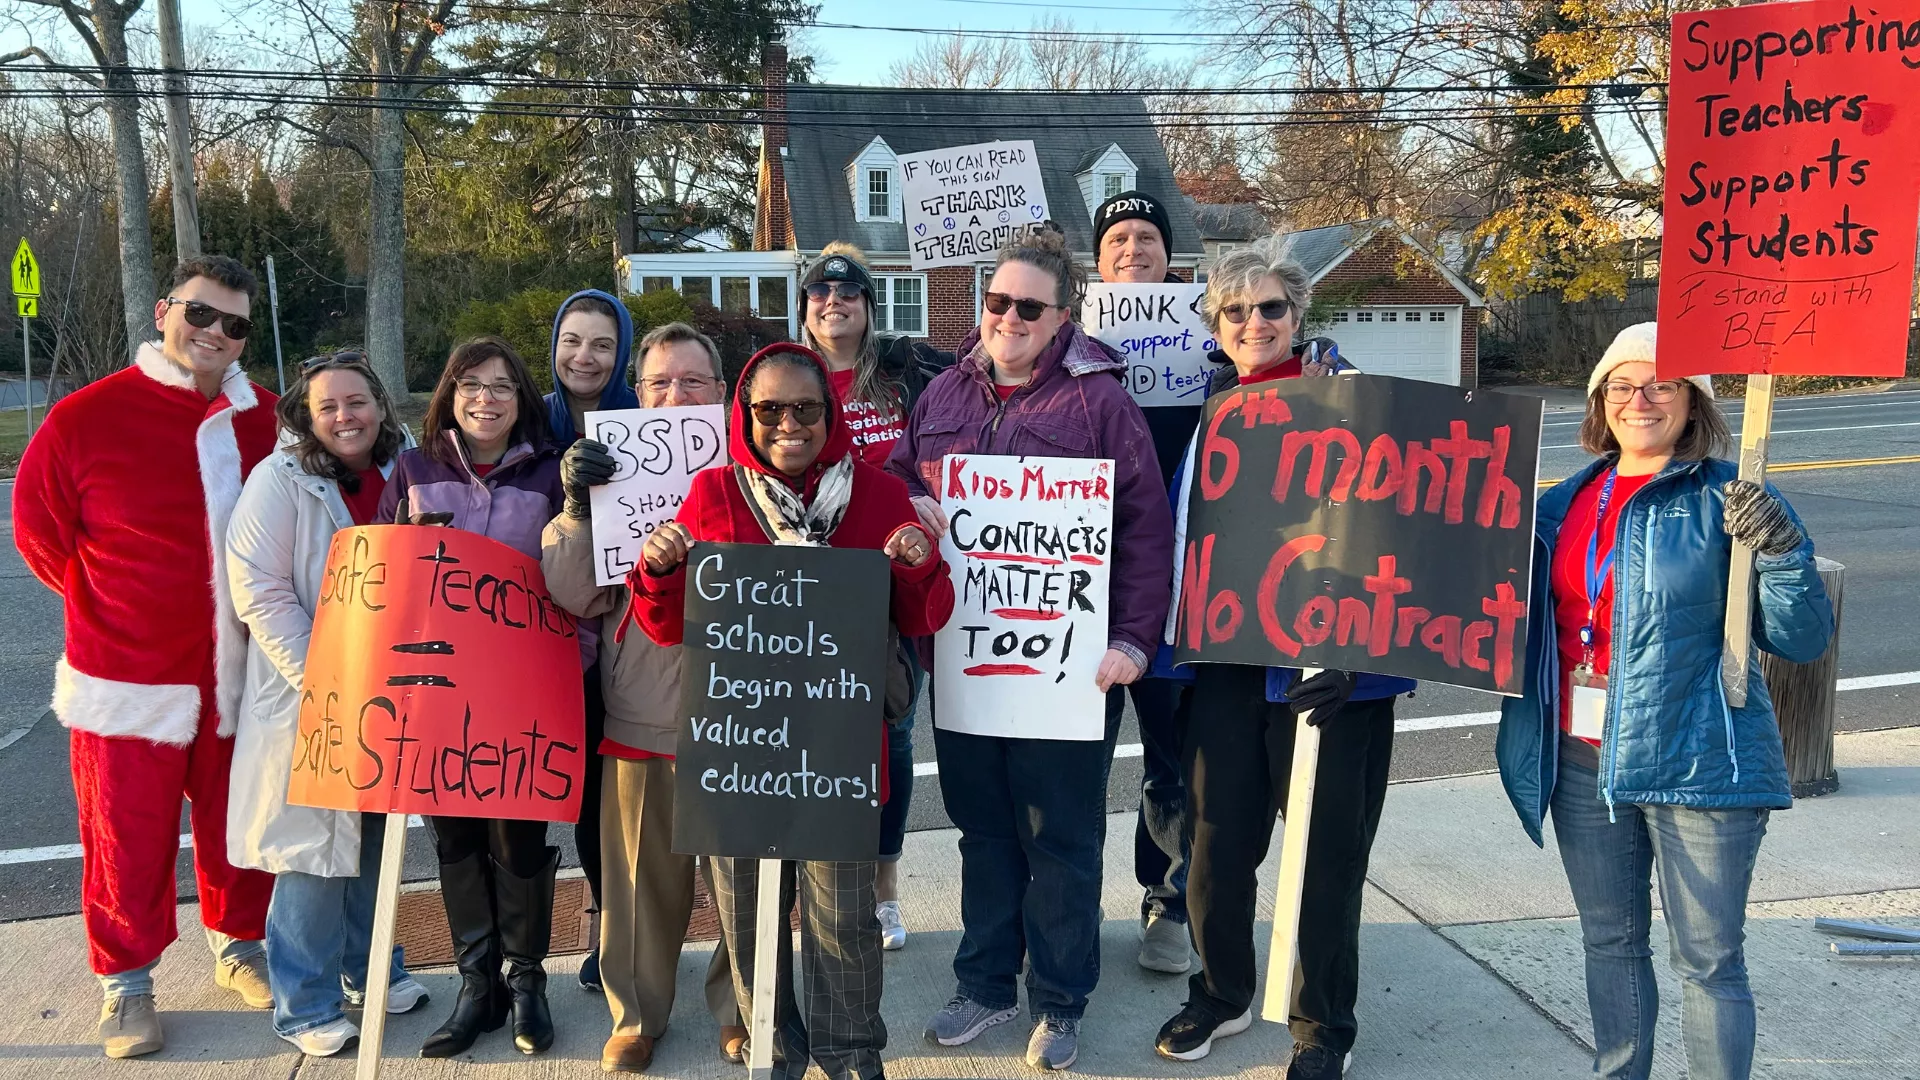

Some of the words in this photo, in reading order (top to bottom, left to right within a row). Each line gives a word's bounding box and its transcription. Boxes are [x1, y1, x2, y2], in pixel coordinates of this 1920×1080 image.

[1684, 5, 1920, 81] Supporting
[1696, 79, 1868, 137] Teachers
[903, 160, 919, 181] IF
[925, 158, 952, 176] YOU
[956, 153, 983, 171] CAN
[988, 148, 1026, 168] READ
[939, 174, 968, 187] THIS
[973, 169, 1000, 182] SIGN
[1680, 138, 1870, 214] Supports
[920, 184, 1027, 216] THANK
[969, 215, 981, 227] A
[1104, 197, 1155, 219] FDNY
[1689, 204, 1878, 266] Students
[1098, 292, 1180, 330] HONK
[1676, 279, 1706, 319] I
[1713, 282, 1788, 307] stand
[1812, 275, 1873, 307] with
[1120, 328, 1194, 359] support
[1722, 310, 1817, 350] BEA
[596, 417, 720, 482] BSD
[1201, 388, 1293, 502] 6th
[1271, 420, 1522, 529] month
[946, 457, 1014, 501] KIDS
[1019, 464, 1110, 502] MATTER
[949, 508, 1109, 562] CONTRACTS
[320, 534, 387, 612] Safe
[695, 553, 819, 607] Great
[963, 563, 1096, 615] MATTER
[705, 614, 839, 657] schools
[1175, 533, 1245, 652] No
[1257, 534, 1527, 689] Contract
[959, 621, 1075, 684] TOO!
[707, 661, 793, 709] begin
[804, 668, 872, 702] with
[292, 687, 343, 781] Safe
[343, 695, 579, 806] Students
[690, 714, 791, 748] valued
[700, 749, 880, 807] educators!
